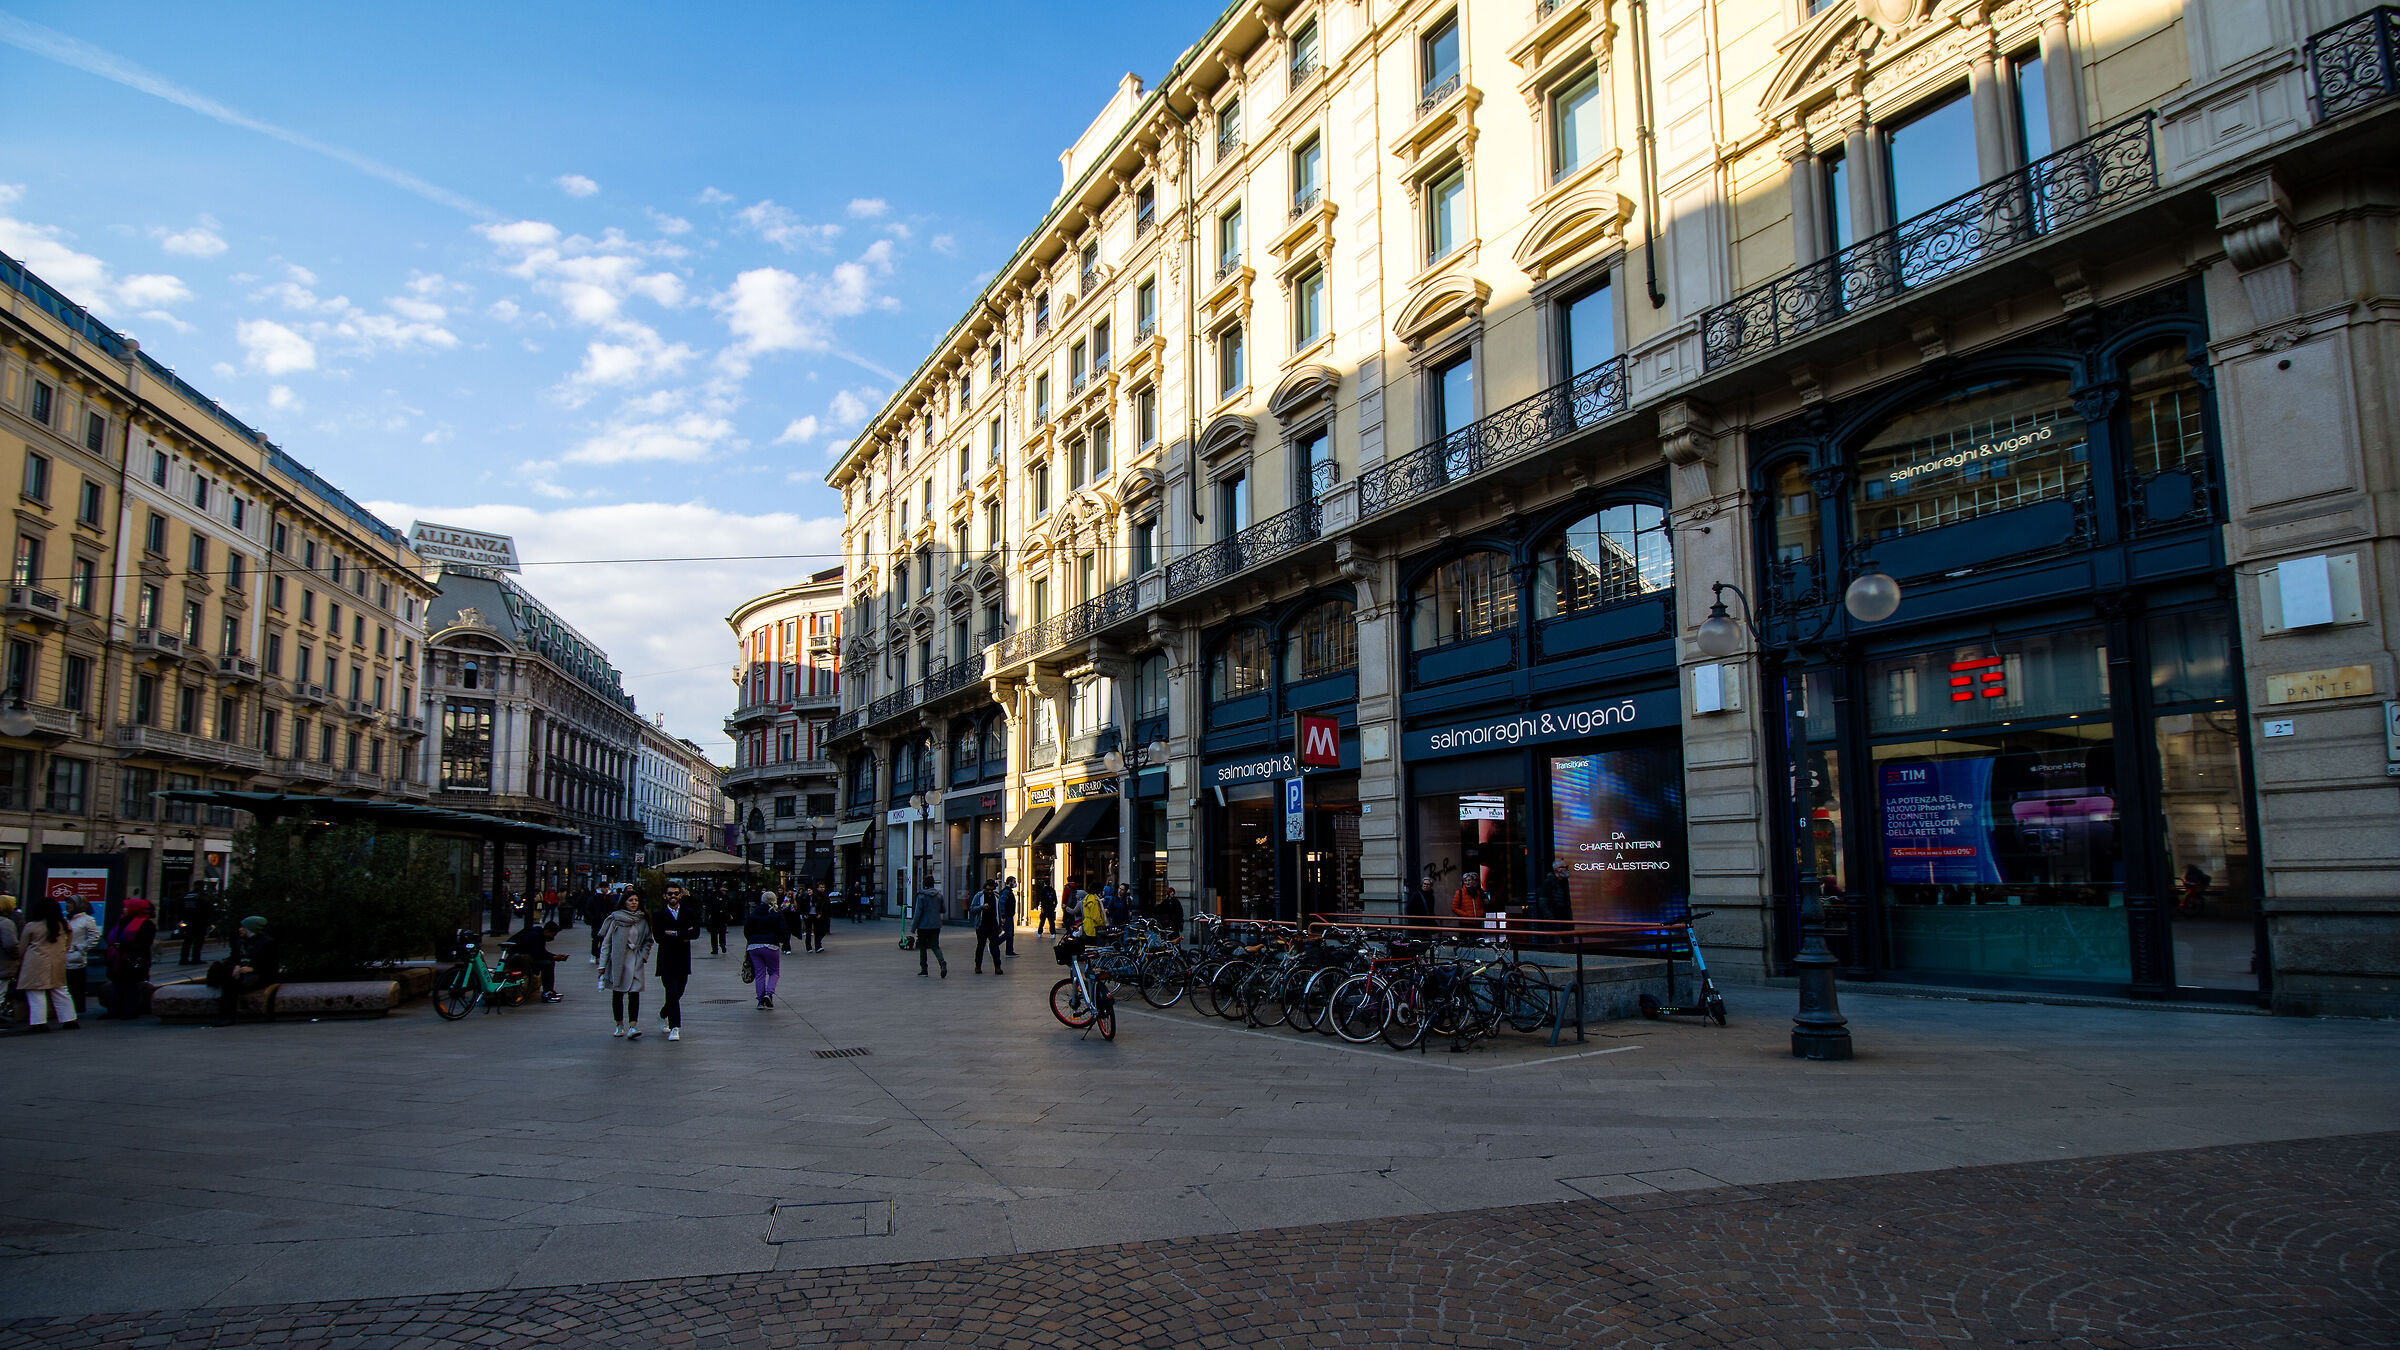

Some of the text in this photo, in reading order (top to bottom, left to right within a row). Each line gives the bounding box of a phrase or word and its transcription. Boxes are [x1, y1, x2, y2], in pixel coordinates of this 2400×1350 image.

[1889, 448, 1978, 483] salmoiraghi
[1979, 444, 1993, 457] &
[415, 528, 511, 555] ALLEANZA
[423, 544, 511, 566] SSICURAZIONI
[2287, 681, 2352, 696] DANTE
[1430, 716, 1537, 750] salmoiraghi
[1541, 713, 1556, 734] &
[1305, 725, 1336, 757] M
[1218, 755, 1282, 781] salmoiraghi
[1283, 755, 1292, 771] &
[1555, 760, 1590, 770] Transitions
[1900, 769, 1927, 781] TIM
[1078, 780, 1102, 793] FUSARO
[1290, 785, 1299, 810] P
[1898, 796, 1938, 804] POTENZA
[1887, 804, 1917, 813] NUOVO
[1918, 803, 1946, 811] iPhone
[1896, 812, 1940, 820] CONNETTE
[1919, 817, 1961, 827] VELOCITÀ
[1799, 817, 1807, 828] 6
[1611, 832, 1626, 840] DA
[1915, 828, 1937, 836] RETE
[1579, 840, 1662, 852] CHIARE IN INTERNI
[1615, 852, 1624, 860] A
[1573, 860, 1671, 872] SCURE ALL'ESTERNO
